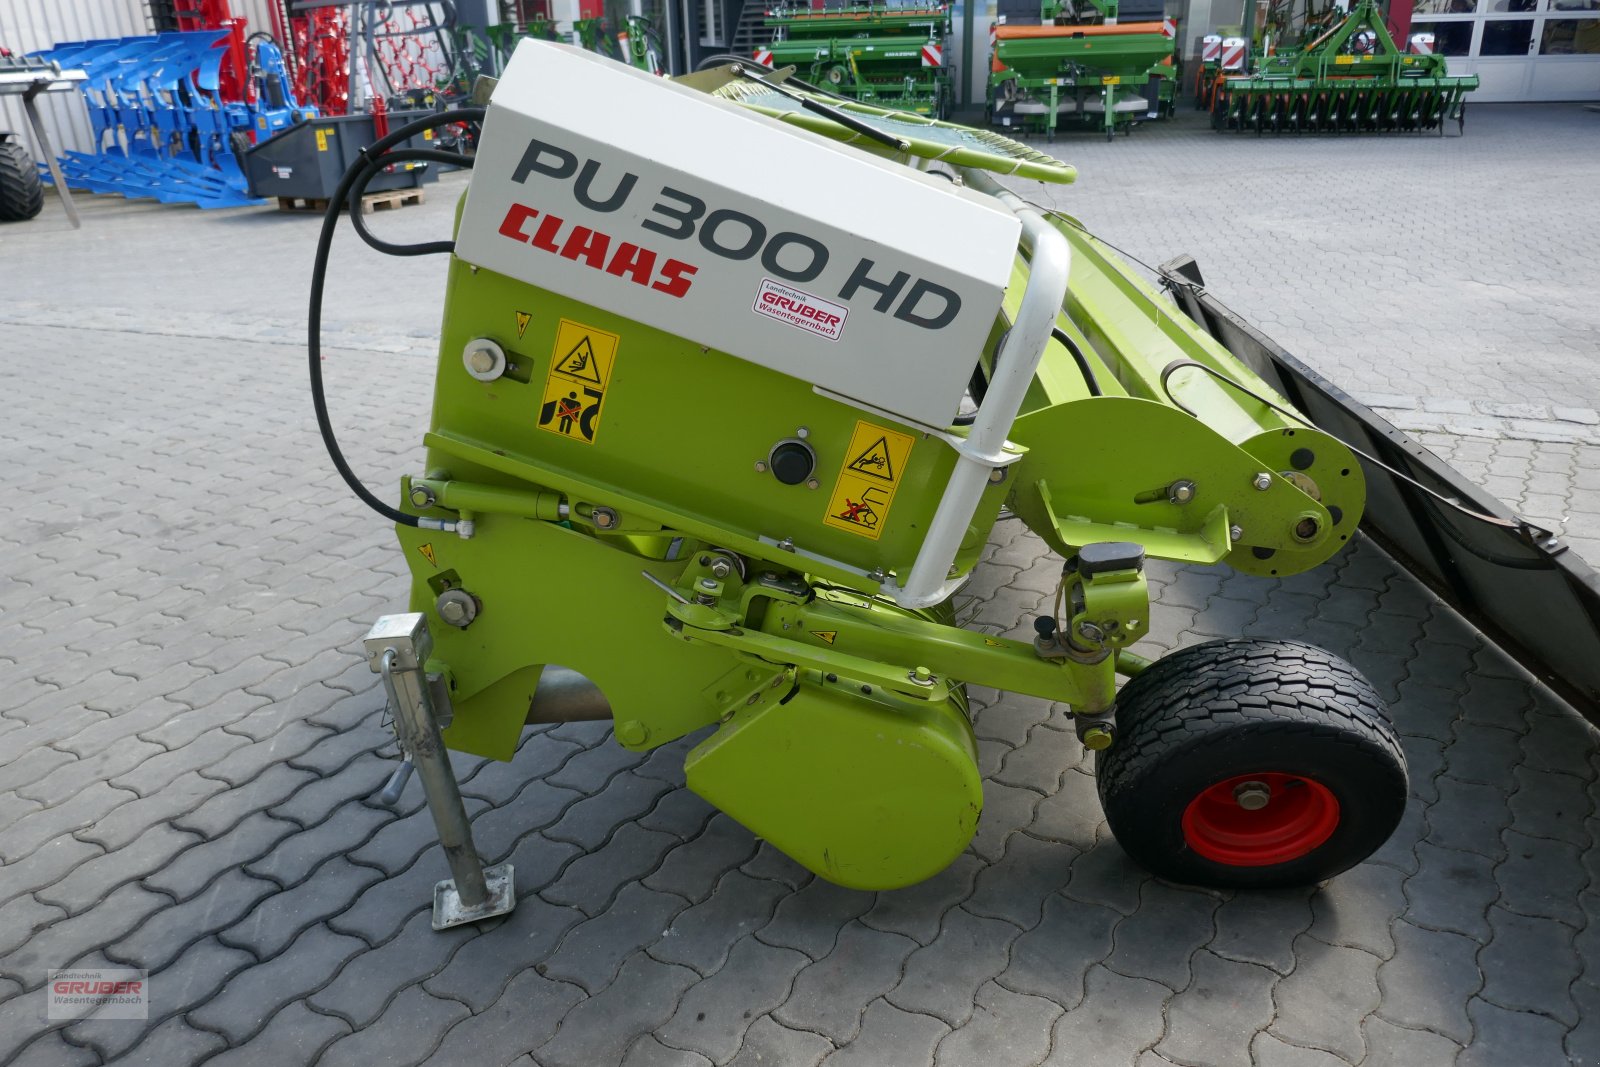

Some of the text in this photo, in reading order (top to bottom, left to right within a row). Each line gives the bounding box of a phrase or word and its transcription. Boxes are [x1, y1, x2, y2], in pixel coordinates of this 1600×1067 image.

[498, 202, 699, 298] CLAAS
[511, 139, 962, 330] PU 300 HD
[762, 292, 840, 327] GRUBER
[766, 283, 807, 302] Landtechnik
[759, 302, 836, 335] Wasentegernbach
